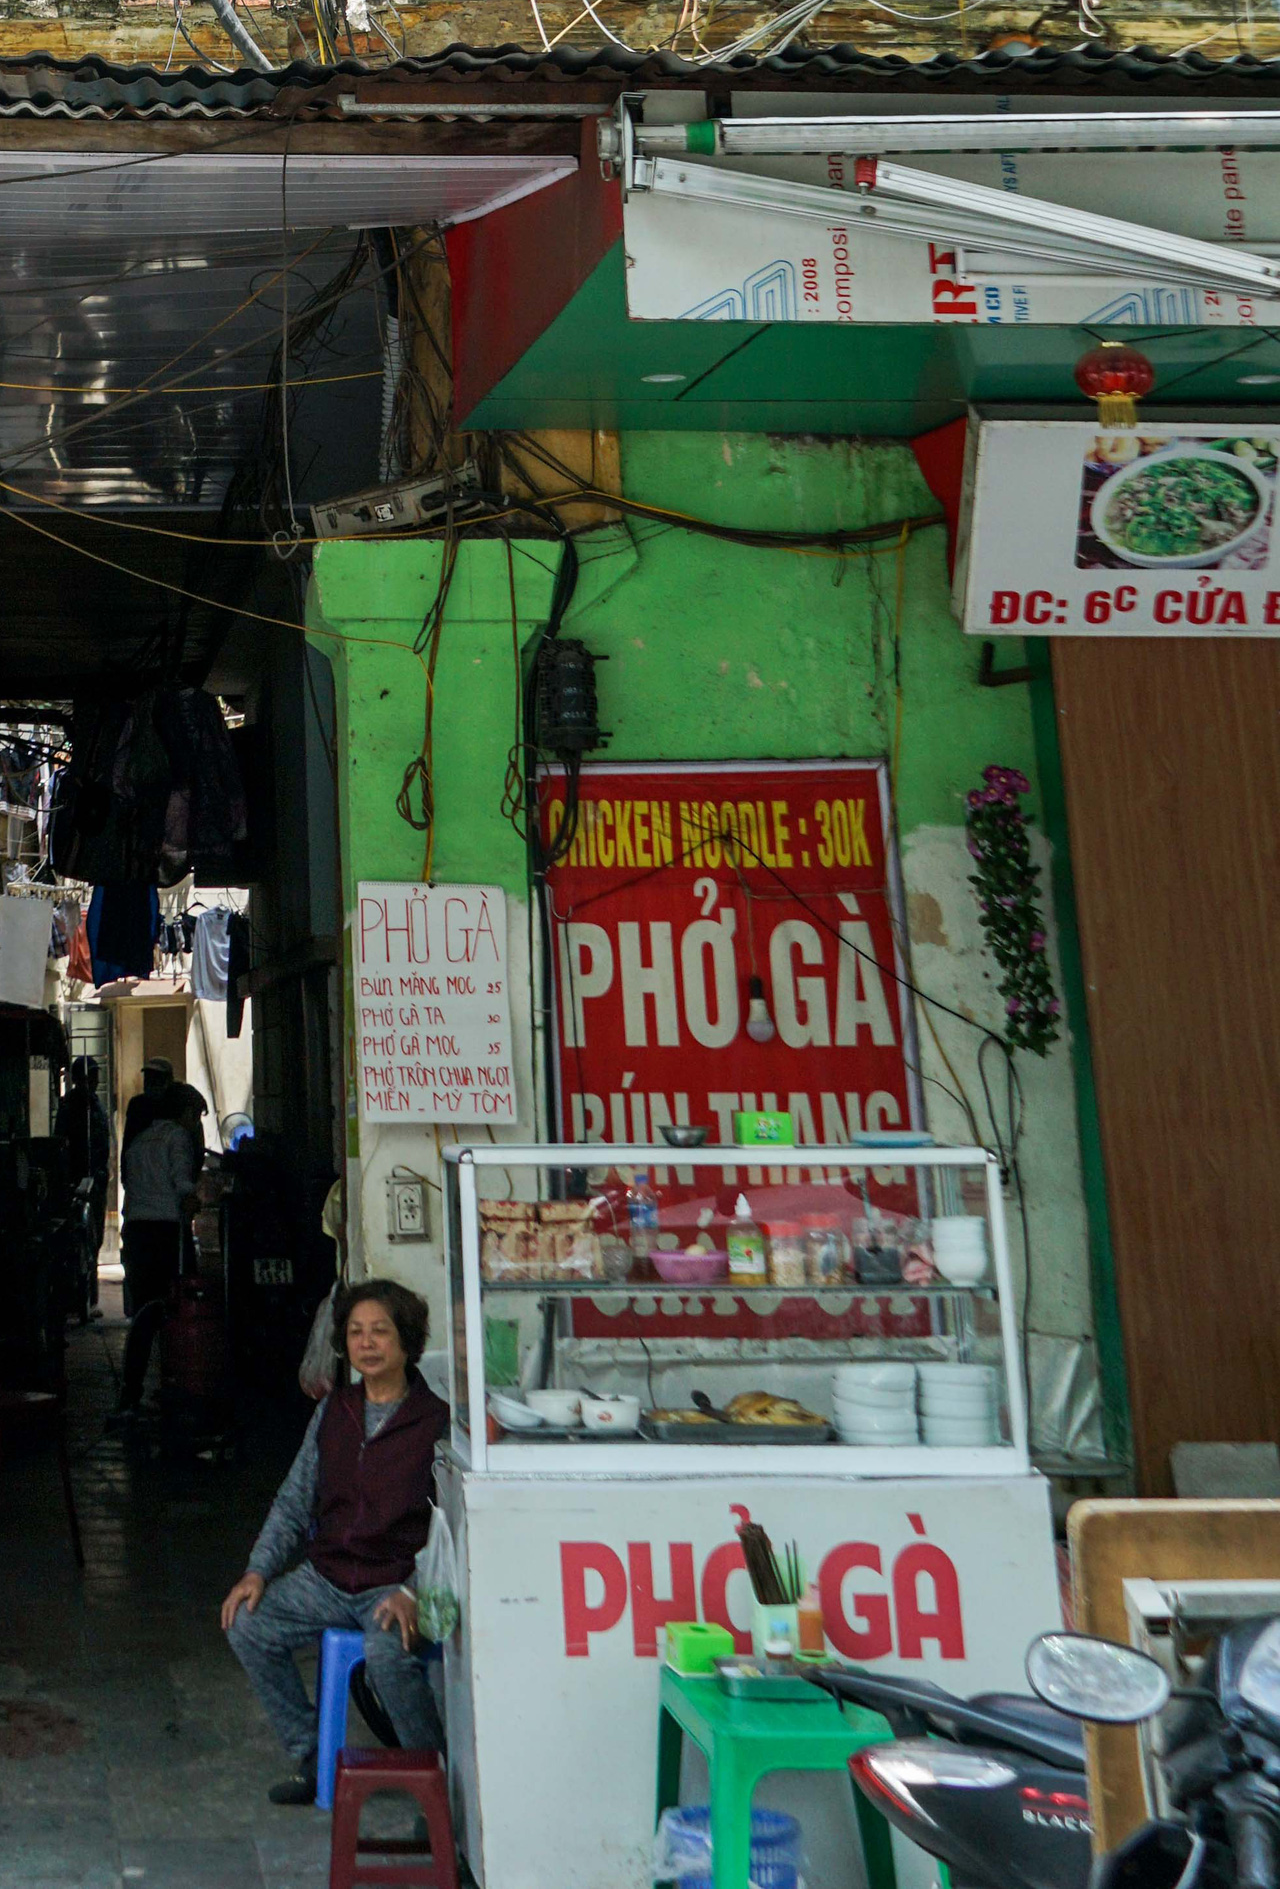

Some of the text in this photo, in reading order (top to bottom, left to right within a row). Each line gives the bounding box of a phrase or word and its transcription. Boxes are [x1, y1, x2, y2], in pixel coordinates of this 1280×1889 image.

[802, 258, 820, 302] 2008
[989, 590, 1068, 624] ĐC:
[1153, 575, 1248, 625] CỬA
[549, 799, 674, 868] CHICKEN
[680, 799, 795, 868] NOODLE
[817, 798, 873, 868] 30K
[361, 888, 500, 963] PHỞ GÀ
[486, 981, 502, 994] 25
[558, 877, 896, 1049] PHỞ GÀ
[399, 1003, 421, 1026] GÀ
[424, 1006, 446, 1025] TA
[469, 1089, 513, 1116] TÔM
[818, 1513, 965, 1660] GÀ
